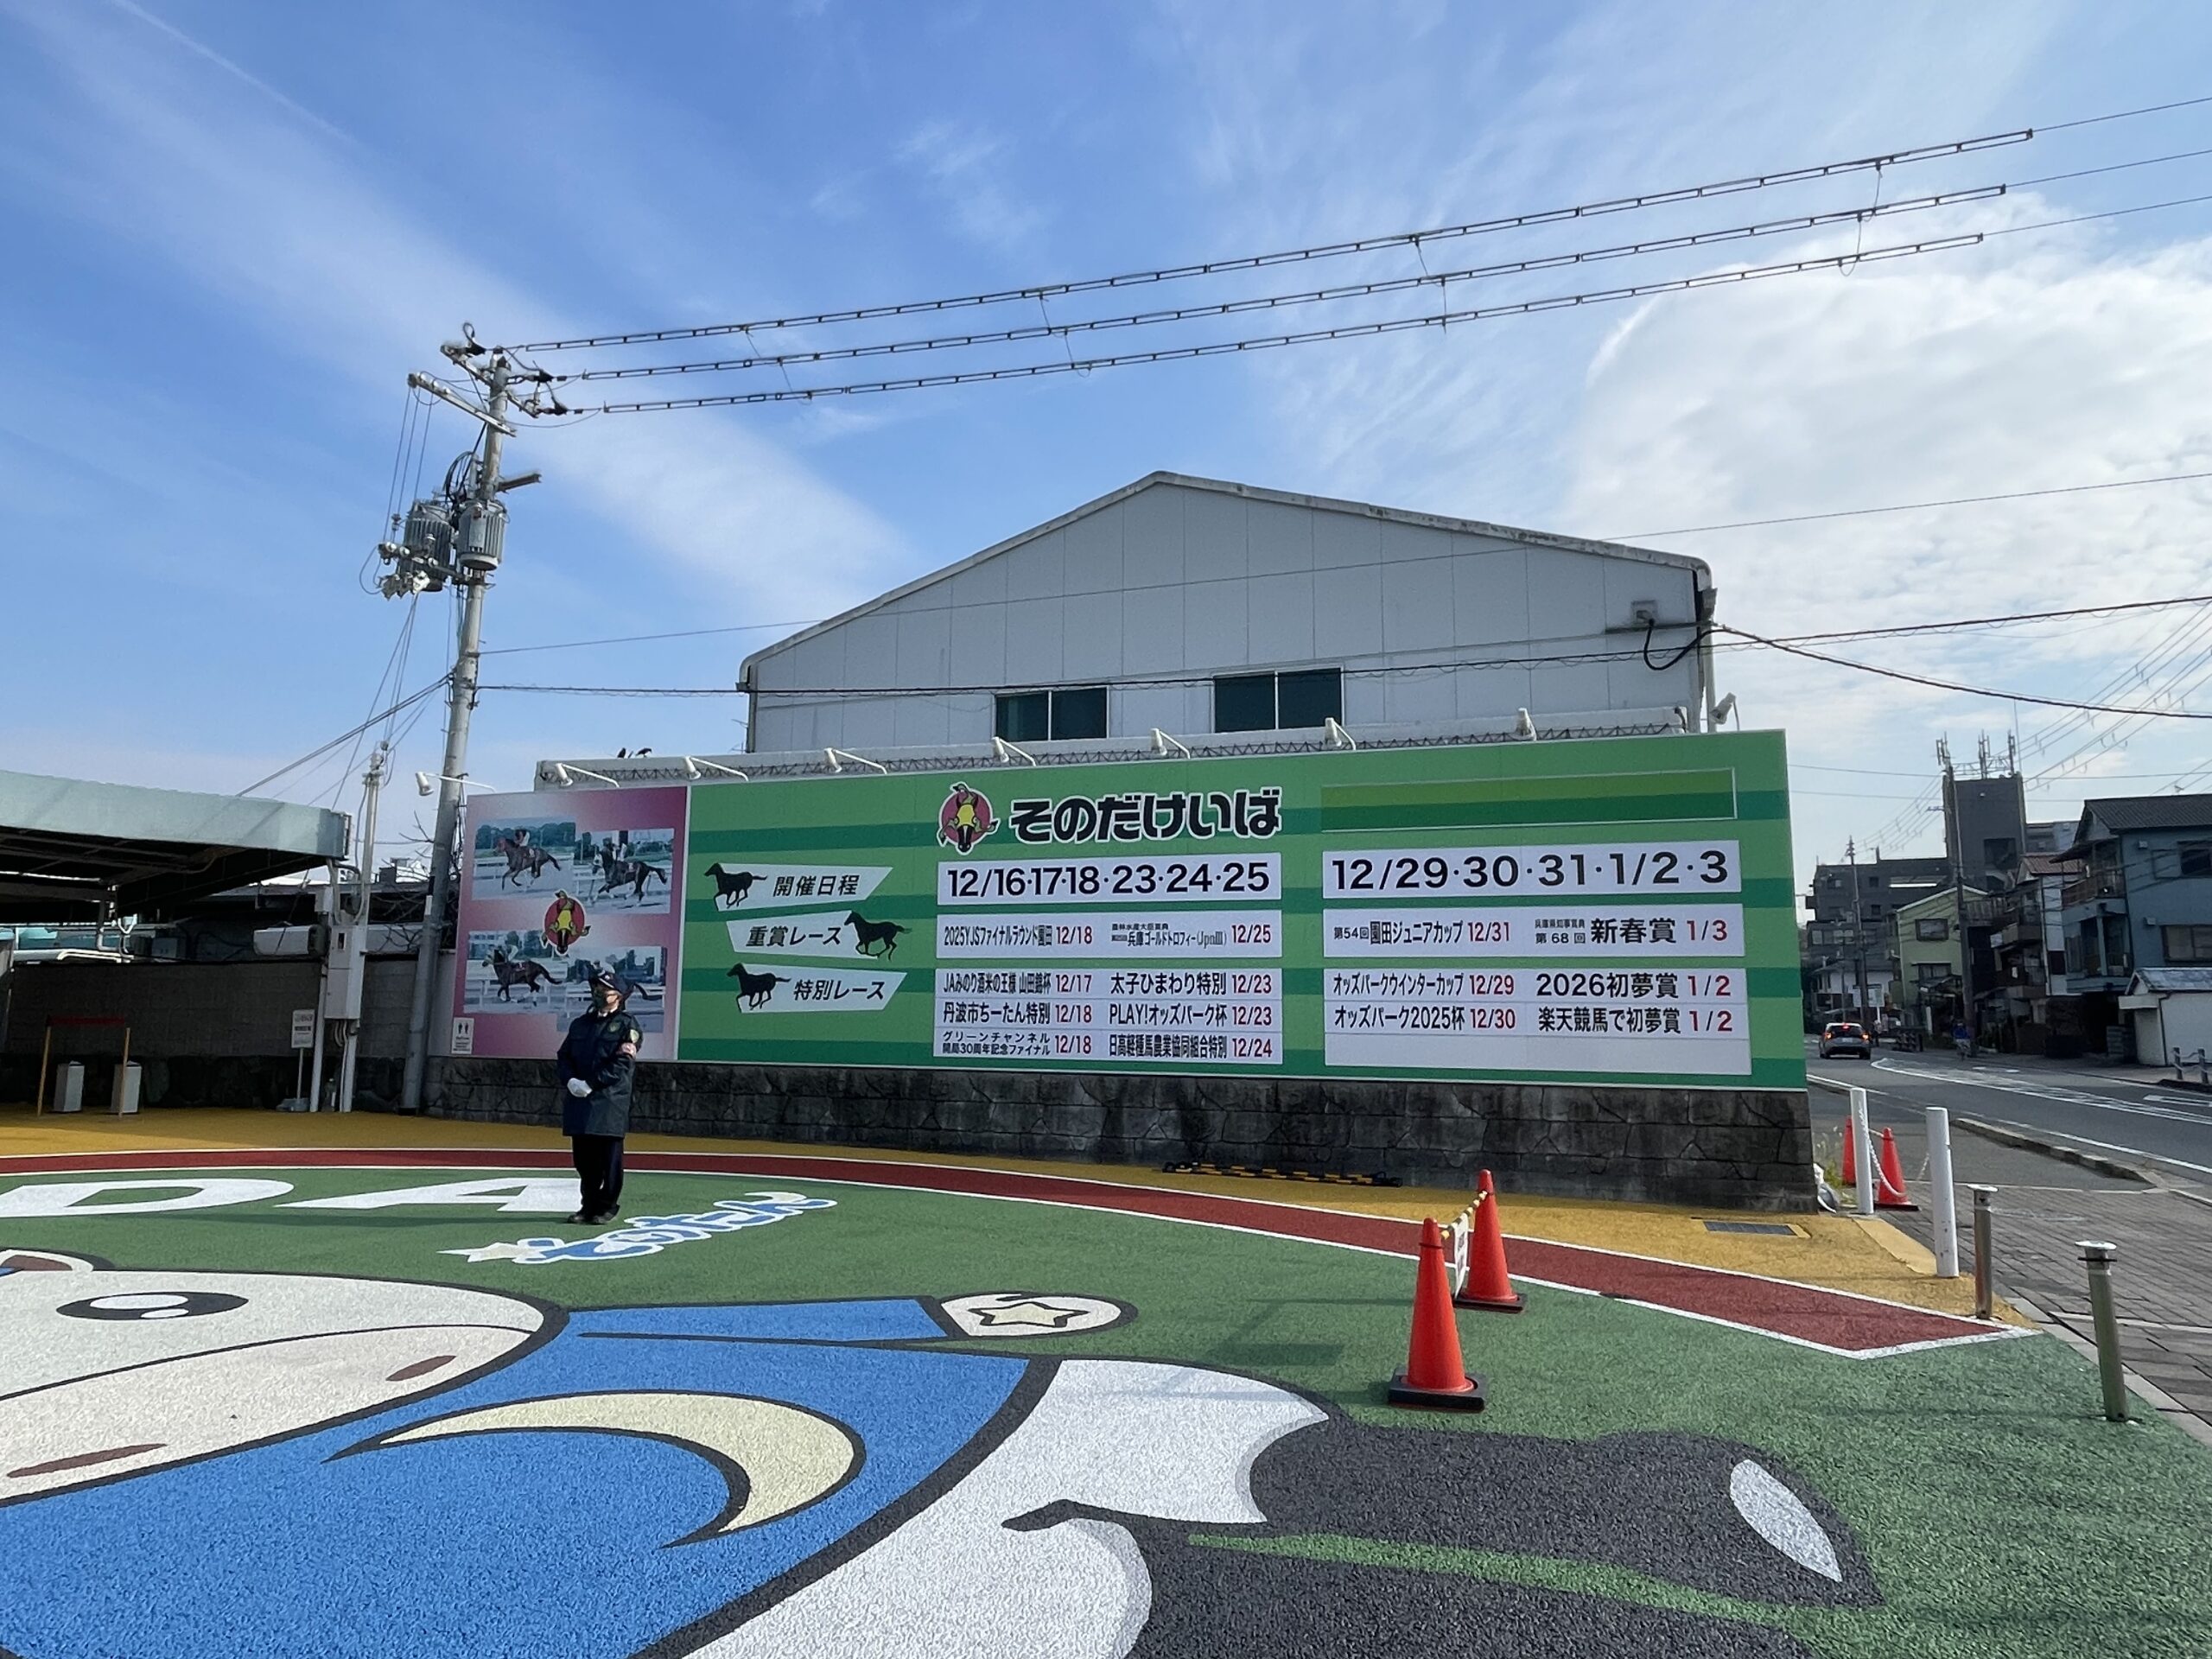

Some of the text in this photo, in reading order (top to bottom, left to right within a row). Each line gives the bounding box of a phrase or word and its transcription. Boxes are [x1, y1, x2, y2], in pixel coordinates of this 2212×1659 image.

[1009, 787, 1282, 843] そのだけいば
[772, 874, 860, 897] 開催日程
[746, 925, 841, 947] 重賞レース
[1056, 926, 1092, 947] 12/18
[1231, 924, 1271, 944] 12/25
[1467, 922, 1510, 942] 12/31
[1591, 918, 1676, 944] 新春賞
[1687, 920, 1727, 941] 1/3
[793, 978, 885, 1001] 特別レース
[1056, 975, 1091, 995] 12/17
[1110, 971, 1272, 995] 太子ひまわり特別 12/23
[1469, 973, 1515, 995] 12/29
[1536, 972, 1731, 999] 2026初夢賞 1/2
[943, 1002, 1091, 1024] 丹波市ちーたん特別 12/18
[1231, 1006, 1272, 1026] 12/23
[1335, 1002, 1516, 1031] オッズパーク2025杯 12/30
[1538, 1007, 1732, 1034] 楽天競馬で初夢賞 1/2
[942, 1034, 1091, 1056] 開局30周年記念ファイナル 12/18
[943, 1031, 1050, 1044] グリーンチャンネル
[1231, 1039, 1272, 1058] 12/24
